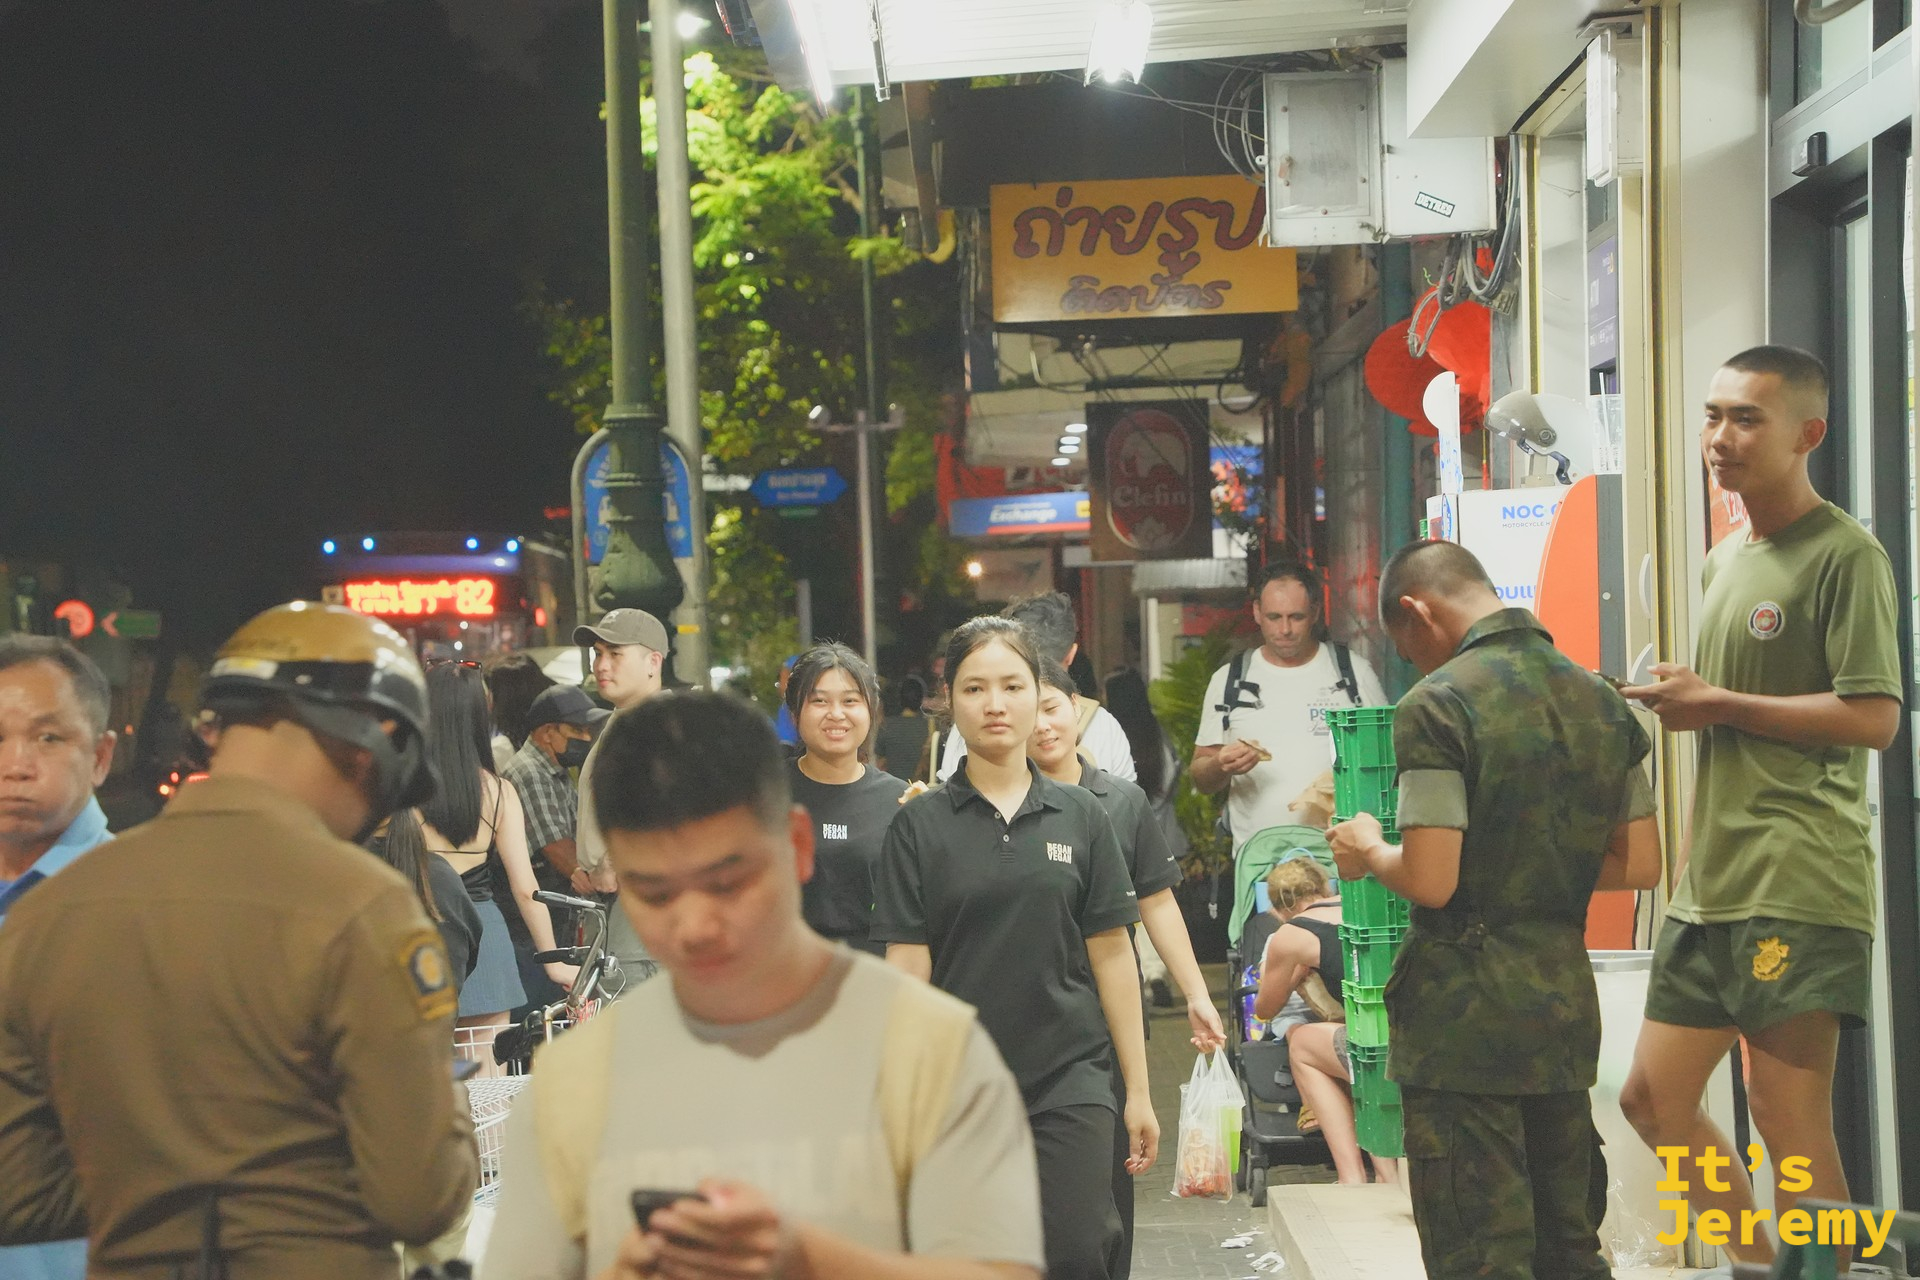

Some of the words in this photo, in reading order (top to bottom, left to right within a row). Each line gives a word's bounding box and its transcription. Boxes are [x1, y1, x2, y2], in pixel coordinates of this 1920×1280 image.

[1013, 186, 1266, 276] ถ่ายรูป
[990, 508, 1057, 523] Exchange
[1502, 504, 1544, 519] NOC
[456, 580, 494, 614] 82
[822, 831, 848, 840] VEGAN
[1047, 850, 1072, 864] VEGAN
